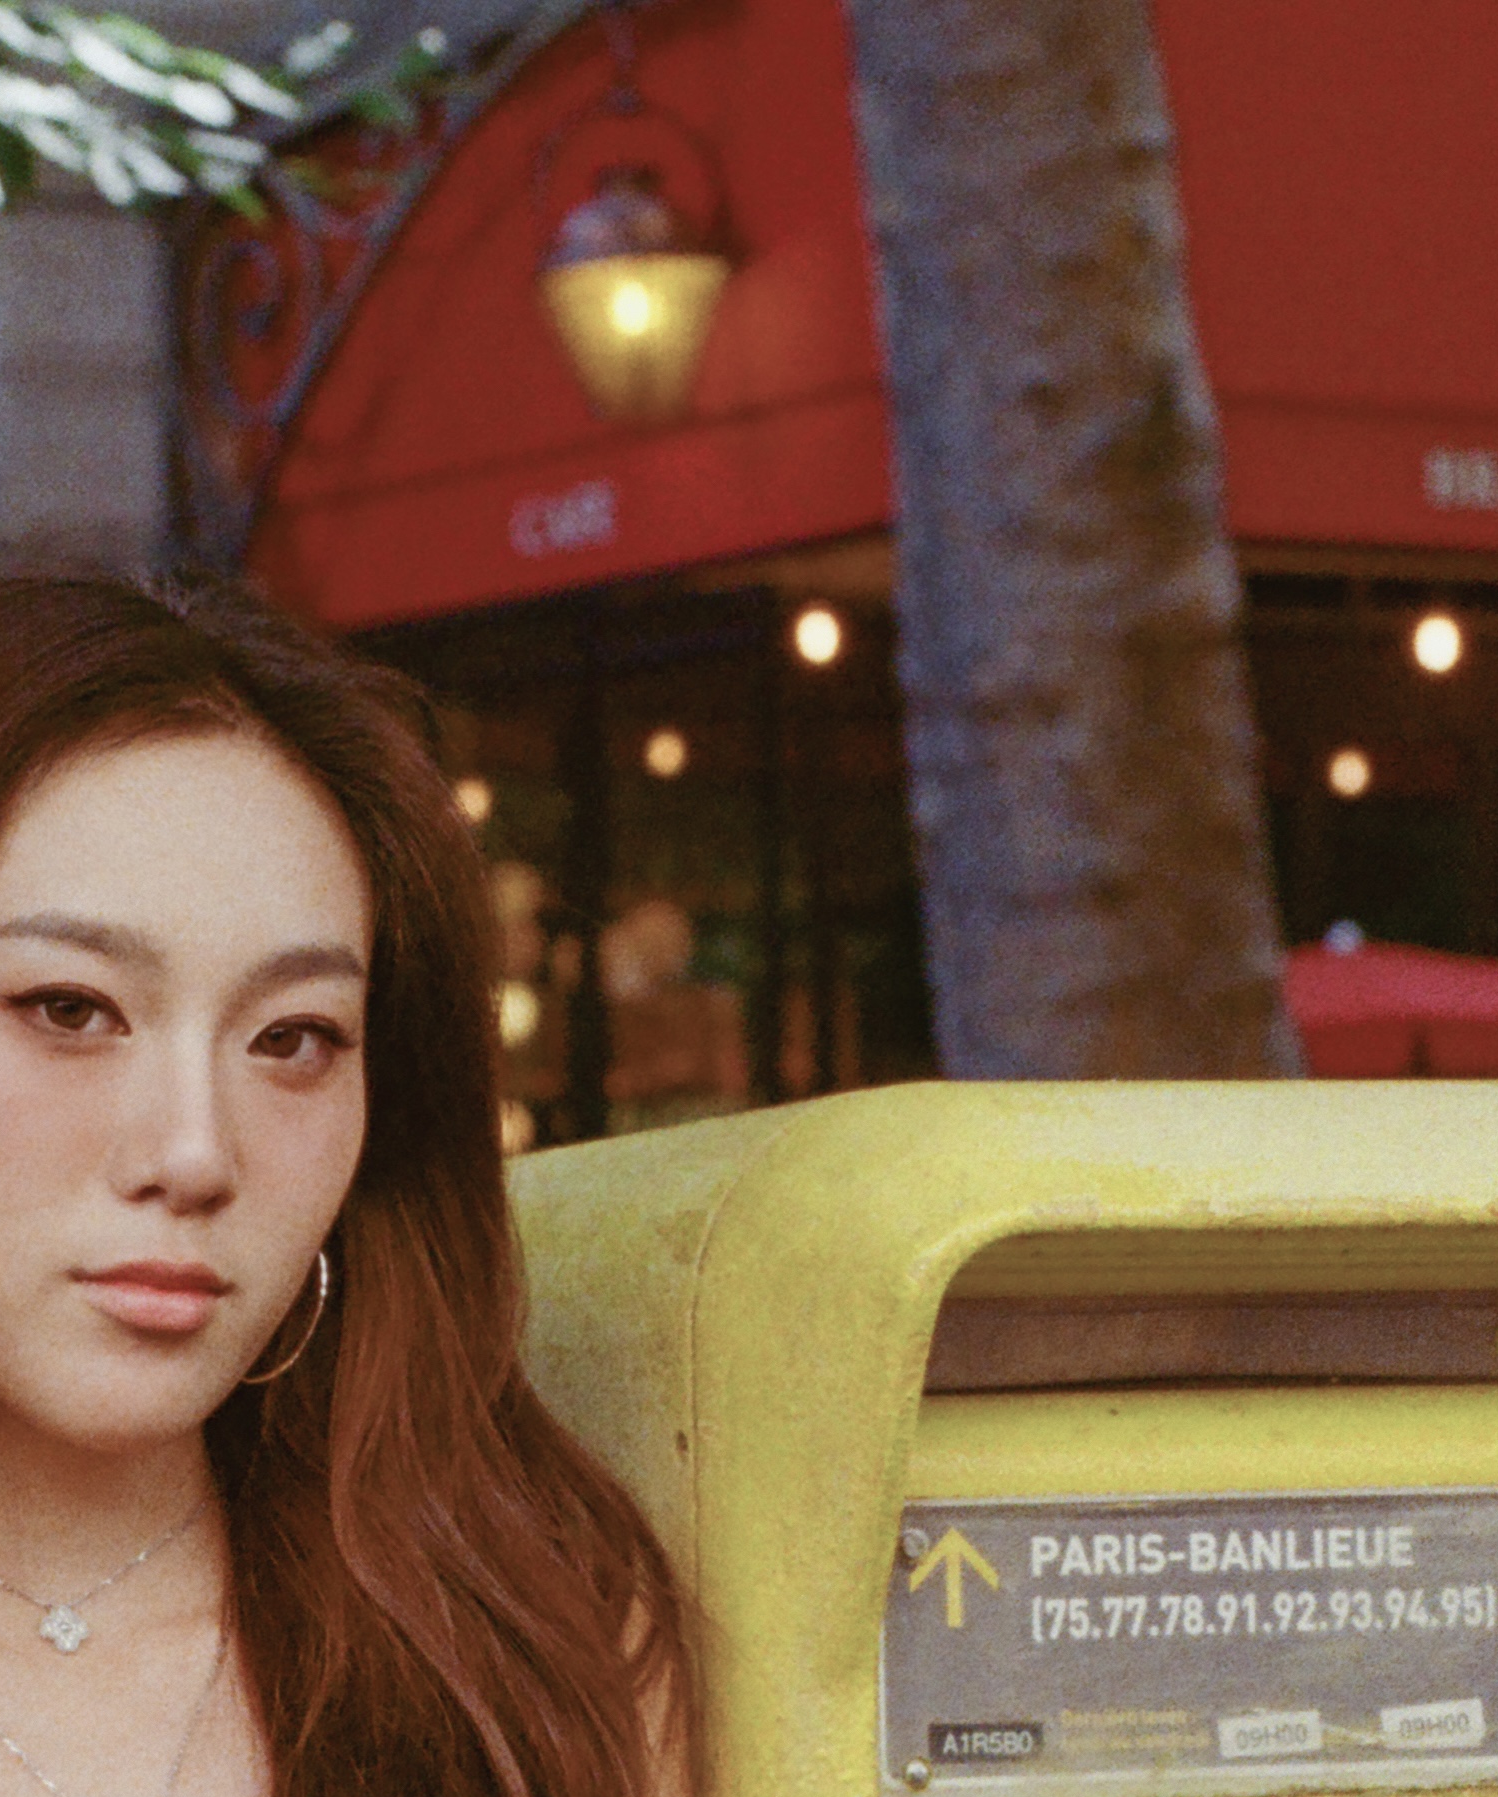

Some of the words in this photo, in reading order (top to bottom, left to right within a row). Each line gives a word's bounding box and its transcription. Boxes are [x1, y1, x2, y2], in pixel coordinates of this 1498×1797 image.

[1030, 1526, 1414, 1578] PARIS-BANLIEUE
[1031, 1584, 1497, 1643] (75.77.78.91.92.93.94.95)
[1234, 1722, 1309, 1750] 09H00
[1398, 1712, 1471, 1741] 09H00
